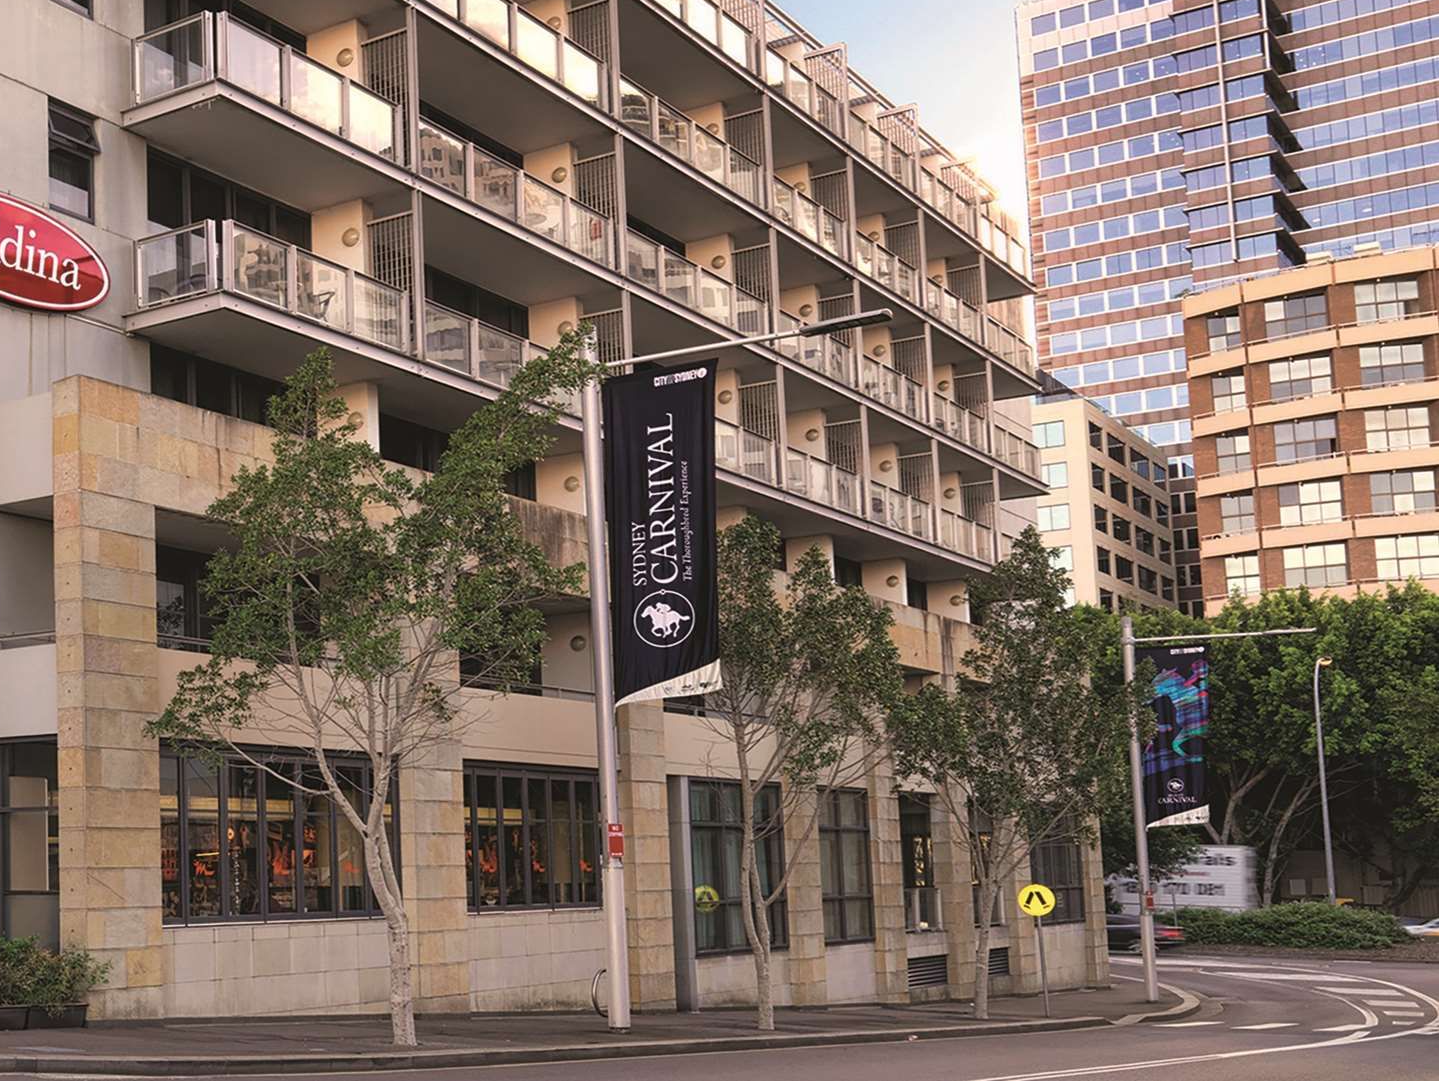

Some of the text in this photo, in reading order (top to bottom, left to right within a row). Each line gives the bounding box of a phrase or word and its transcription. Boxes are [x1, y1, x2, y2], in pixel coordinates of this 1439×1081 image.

[632, 522, 647, 587] SYDNEY
[647, 412, 679, 584] CARNIVAL
[679, 460, 694, 582] The Thoroughbred Experience
